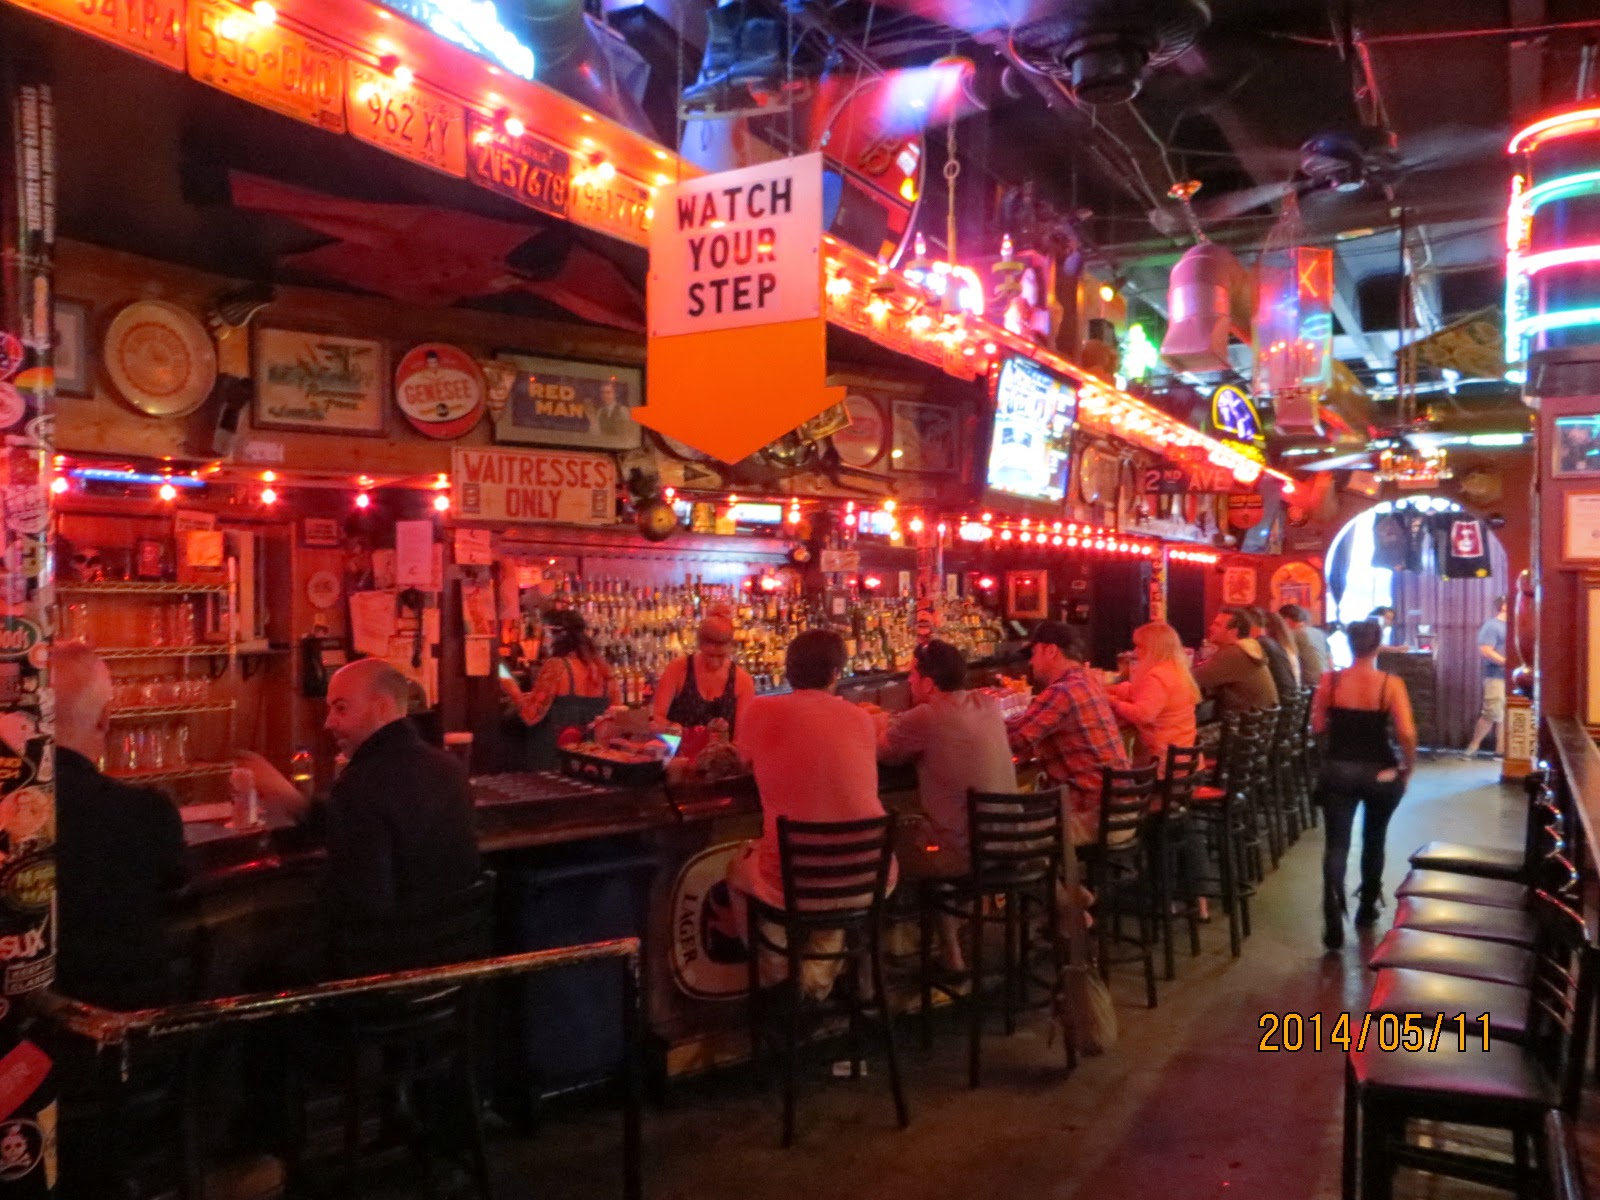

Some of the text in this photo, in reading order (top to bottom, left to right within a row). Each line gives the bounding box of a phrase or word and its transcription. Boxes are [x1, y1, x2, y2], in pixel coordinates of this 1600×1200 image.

[367, 92, 449, 156] 962 XY
[676, 177, 793, 232] WATCH
[688, 227, 777, 272] YOUR
[687, 272, 777, 317] STEP
[403, 378, 473, 405] GENESEE
[527, 382, 576, 401] RED
[534, 400, 585, 418] MAN
[463, 453, 608, 489] WAITRESSES
[505, 487, 563, 519] ONLY
[678, 893, 700, 964] LAGER
